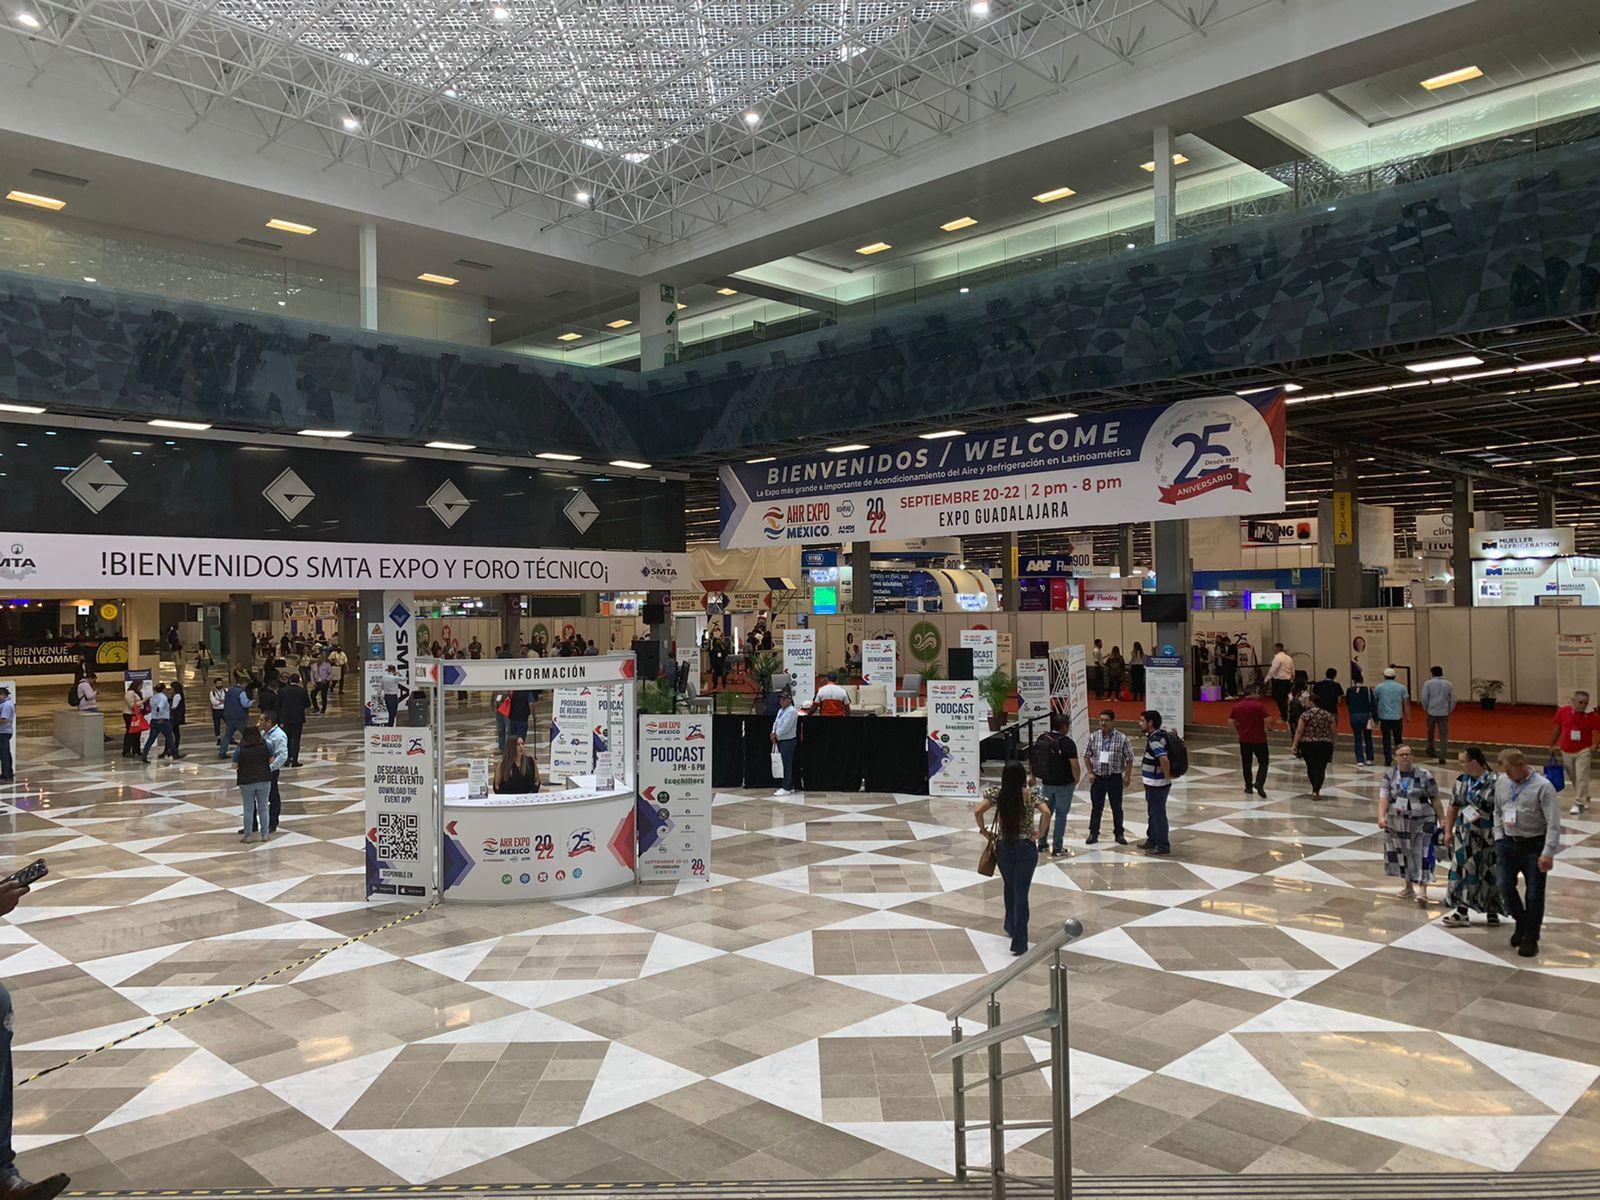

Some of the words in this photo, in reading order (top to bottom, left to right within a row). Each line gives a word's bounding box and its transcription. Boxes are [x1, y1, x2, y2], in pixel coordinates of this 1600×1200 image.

[767, 448, 929, 485] BIENVENIDOS
[965, 421, 1121, 462] WELCOME
[1171, 422, 1232, 485] 25
[1204, 458, 1224, 466] Desde
[1225, 456, 1239, 464] 1997
[765, 488, 780, 498] Expo
[781, 486, 794, 494] más
[795, 484, 817, 495] grande
[824, 480, 861, 491] importante
[863, 478, 872, 486] de
[873, 471, 946, 485] Acondicionamiento
[947, 468, 960, 477] del
[961, 466, 978, 476] Aire
[979, 466, 986, 475] y
[987, 457, 1045, 473] Refrigeración
[1047, 458, 1059, 466] en
[1061, 447, 1132, 464] Latinoamérica
[1177, 472, 1233, 497] ANIVERSARIO
[900, 489, 979, 509] SEPTIEMBRE
[983, 485, 1020, 501] 20-22
[1031, 483, 1040, 497] 2
[1044, 481, 1068, 498] pm
[1082, 477, 1092, 491] 8
[1096, 476, 1122, 493] pm
[787, 504, 805, 523] AHR
[807, 502, 830, 522] EXPO
[866, 497, 884, 520] 20
[939, 509, 970, 527] EXPO
[975, 500, 1069, 525] GUADALAJARA
[869, 510, 886, 534] 22
[0, 558, 36, 568] MTA
[101, 551, 299, 577] !BIENVENIDOS
[307, 556, 372, 579] SMTA
[380, 558, 439, 580] EXPO
[444, 558, 458, 579] Y
[464, 559, 520, 580] FORO
[1026, 560, 1052, 572] AAF
[1073, 555, 1090, 567] 900
[651, 568, 678, 576] SMTA
[1364, 614, 1379, 622] SALA
[1380, 614, 1384, 622] 4
[14, 646, 69, 657] BIENVENUE
[788, 648, 812, 656] PODCAST
[974, 650, 994, 658] DCAST
[13, 655, 80, 666] WILLKOMME
[395, 630, 410, 703] SMTA
[504, 665, 586, 681] INFORMACIÓN
[560, 699, 587, 707] PROGRAMA
[935, 703, 974, 714] PODCAST
[567, 707, 587, 715] REGALOS
[650, 746, 706, 762] PODCAST
[377, 765, 409, 775] DESCARGA
[411, 766, 419, 775] LA
[673, 763, 677, 771] 3
[678, 763, 687, 771] PM
[691, 763, 696, 771] 6
[697, 763, 705, 771] PM
[373, 775, 386, 784] APP
[387, 775, 398, 785] DEL
[400, 776, 424, 786] EVENTO
[664, 777, 705, 785] Ecochillers
[378, 786, 406, 795] DOWNLOAD
[407, 787, 417, 796] THE
[384, 795, 400, 804] EVENT
[401, 796, 412, 804] APP
[500, 838, 513, 848] AHR
[514, 837, 531, 847] EXPO
[534, 834, 552, 852] 20
[572, 831, 591, 851] 25
[537, 843, 554, 860] 22
[382, 870, 407, 879] DISPONIBLE
